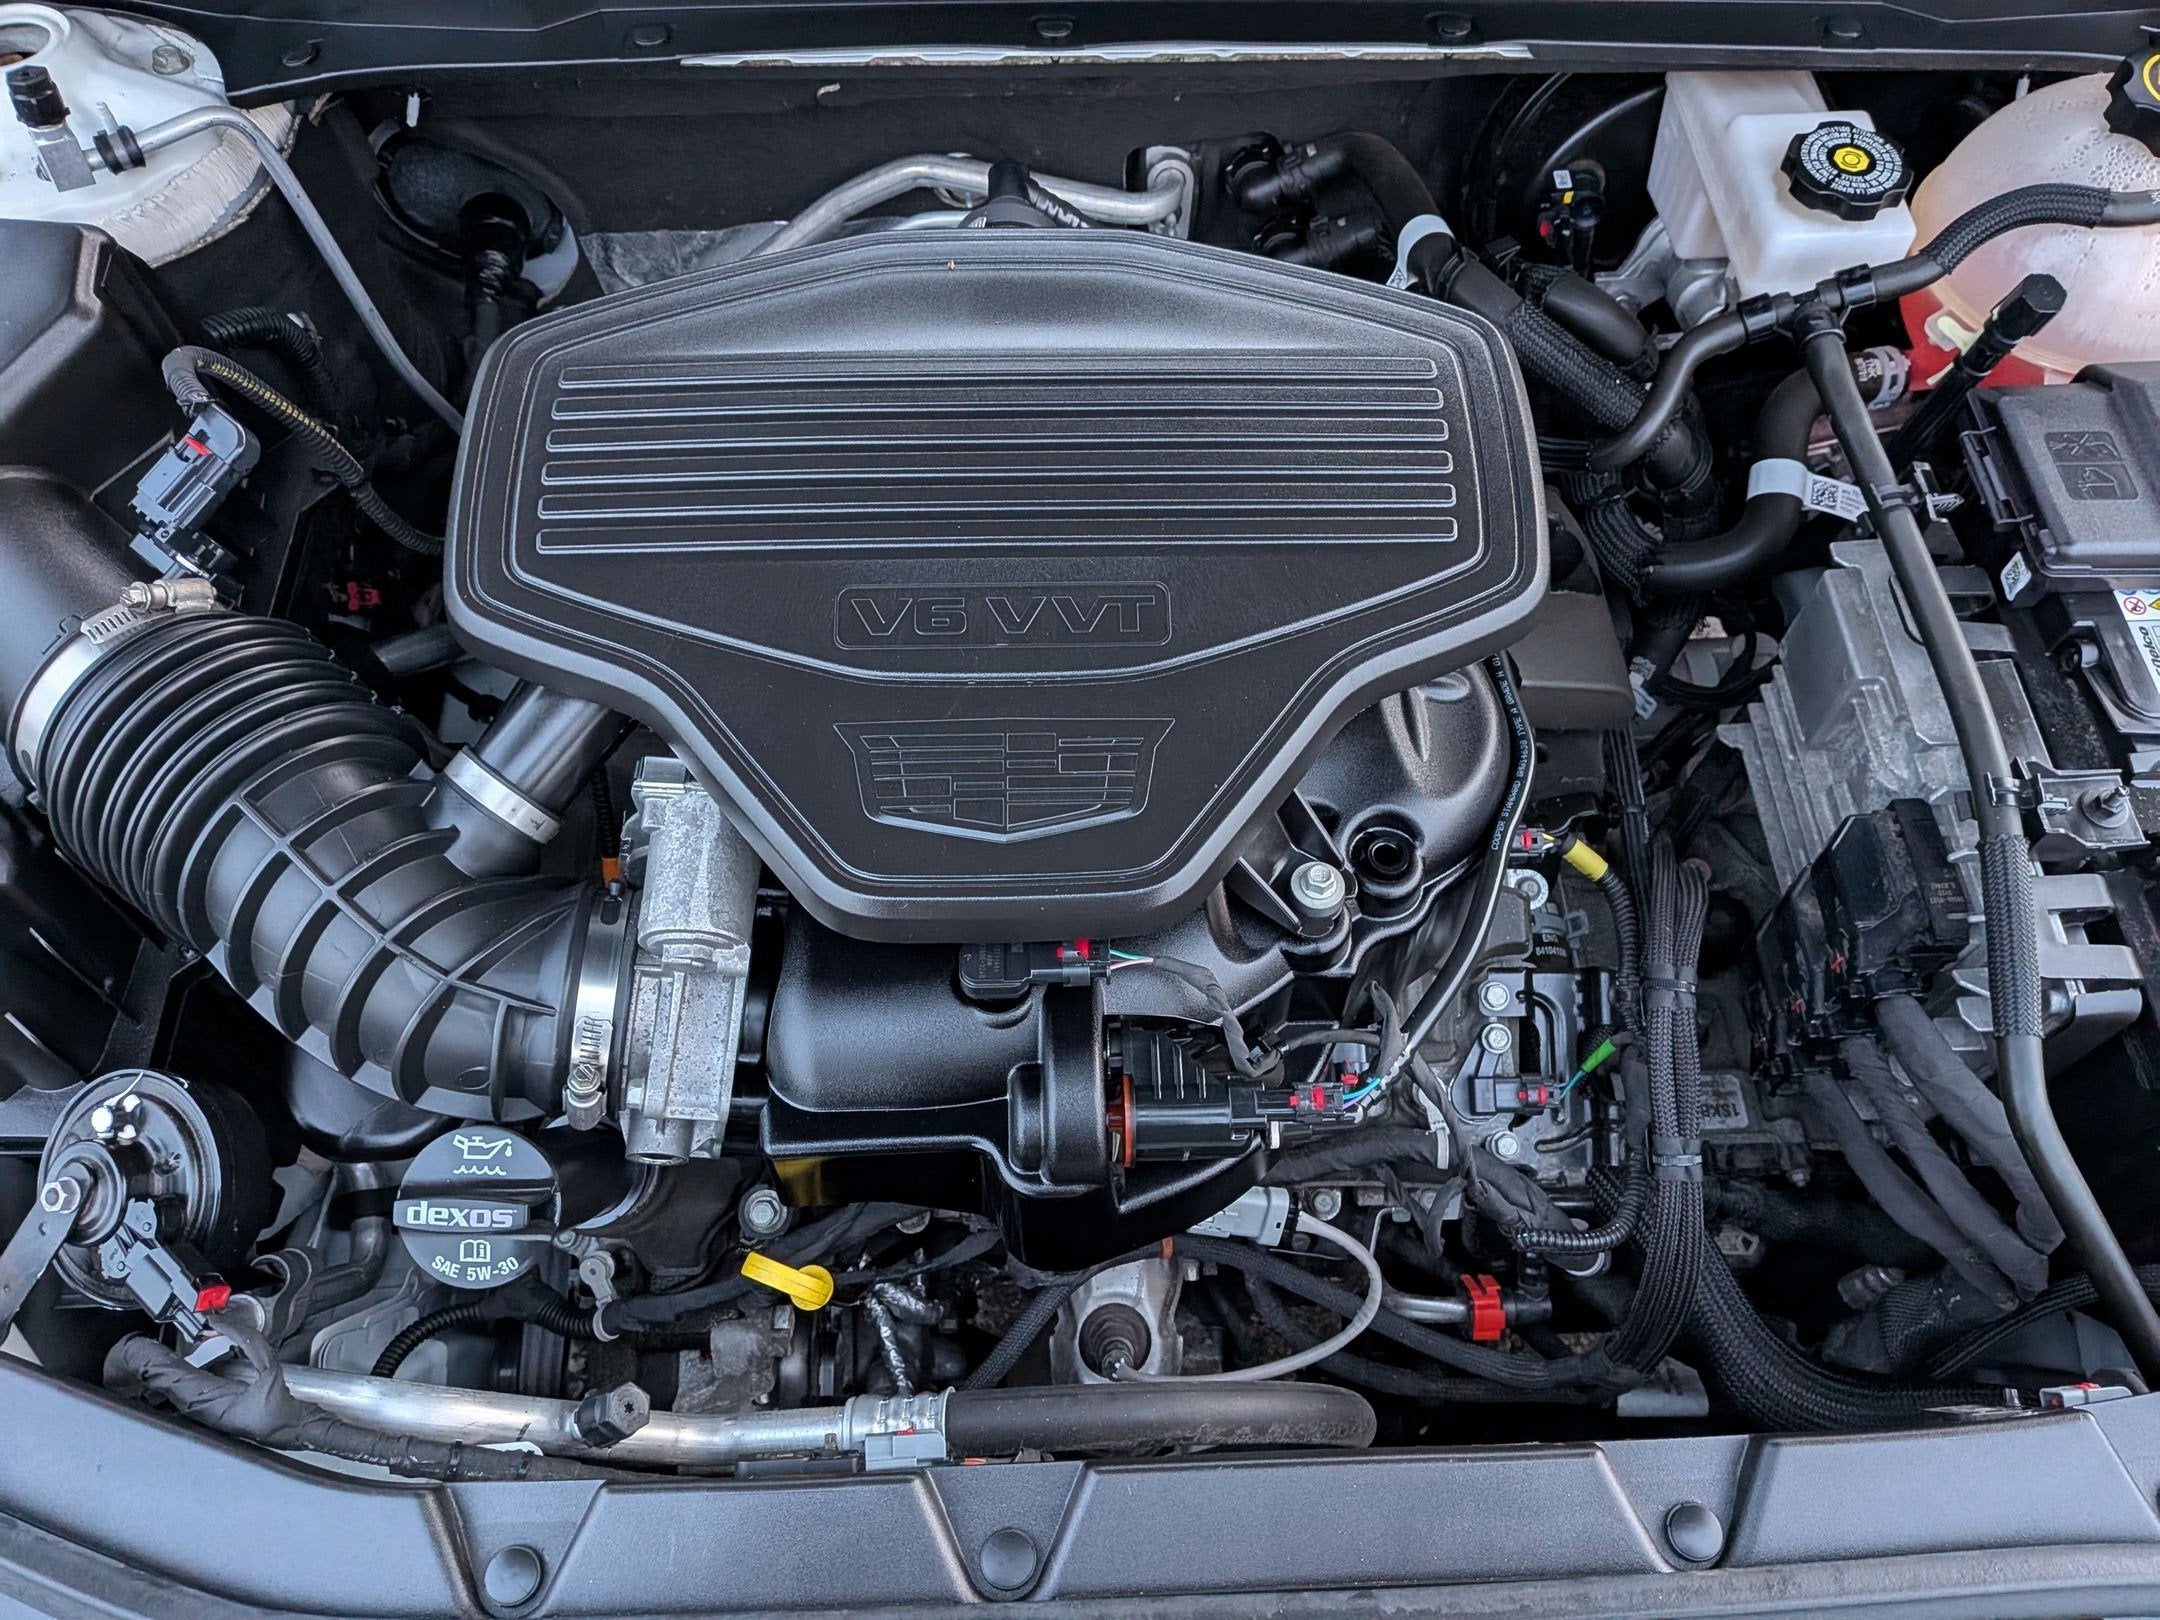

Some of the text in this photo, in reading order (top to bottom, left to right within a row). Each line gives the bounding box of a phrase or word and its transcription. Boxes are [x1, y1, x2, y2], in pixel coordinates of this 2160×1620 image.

[850, 595, 1156, 636] V6 VVT
[2139, 626, 2160, 676] Delco
[1491, 821, 1506, 850] COOPER
[1502, 781, 1521, 817] STANDARD
[406, 1200, 513, 1228] dexos
[431, 1255, 519, 1281] SAE 5W-30
